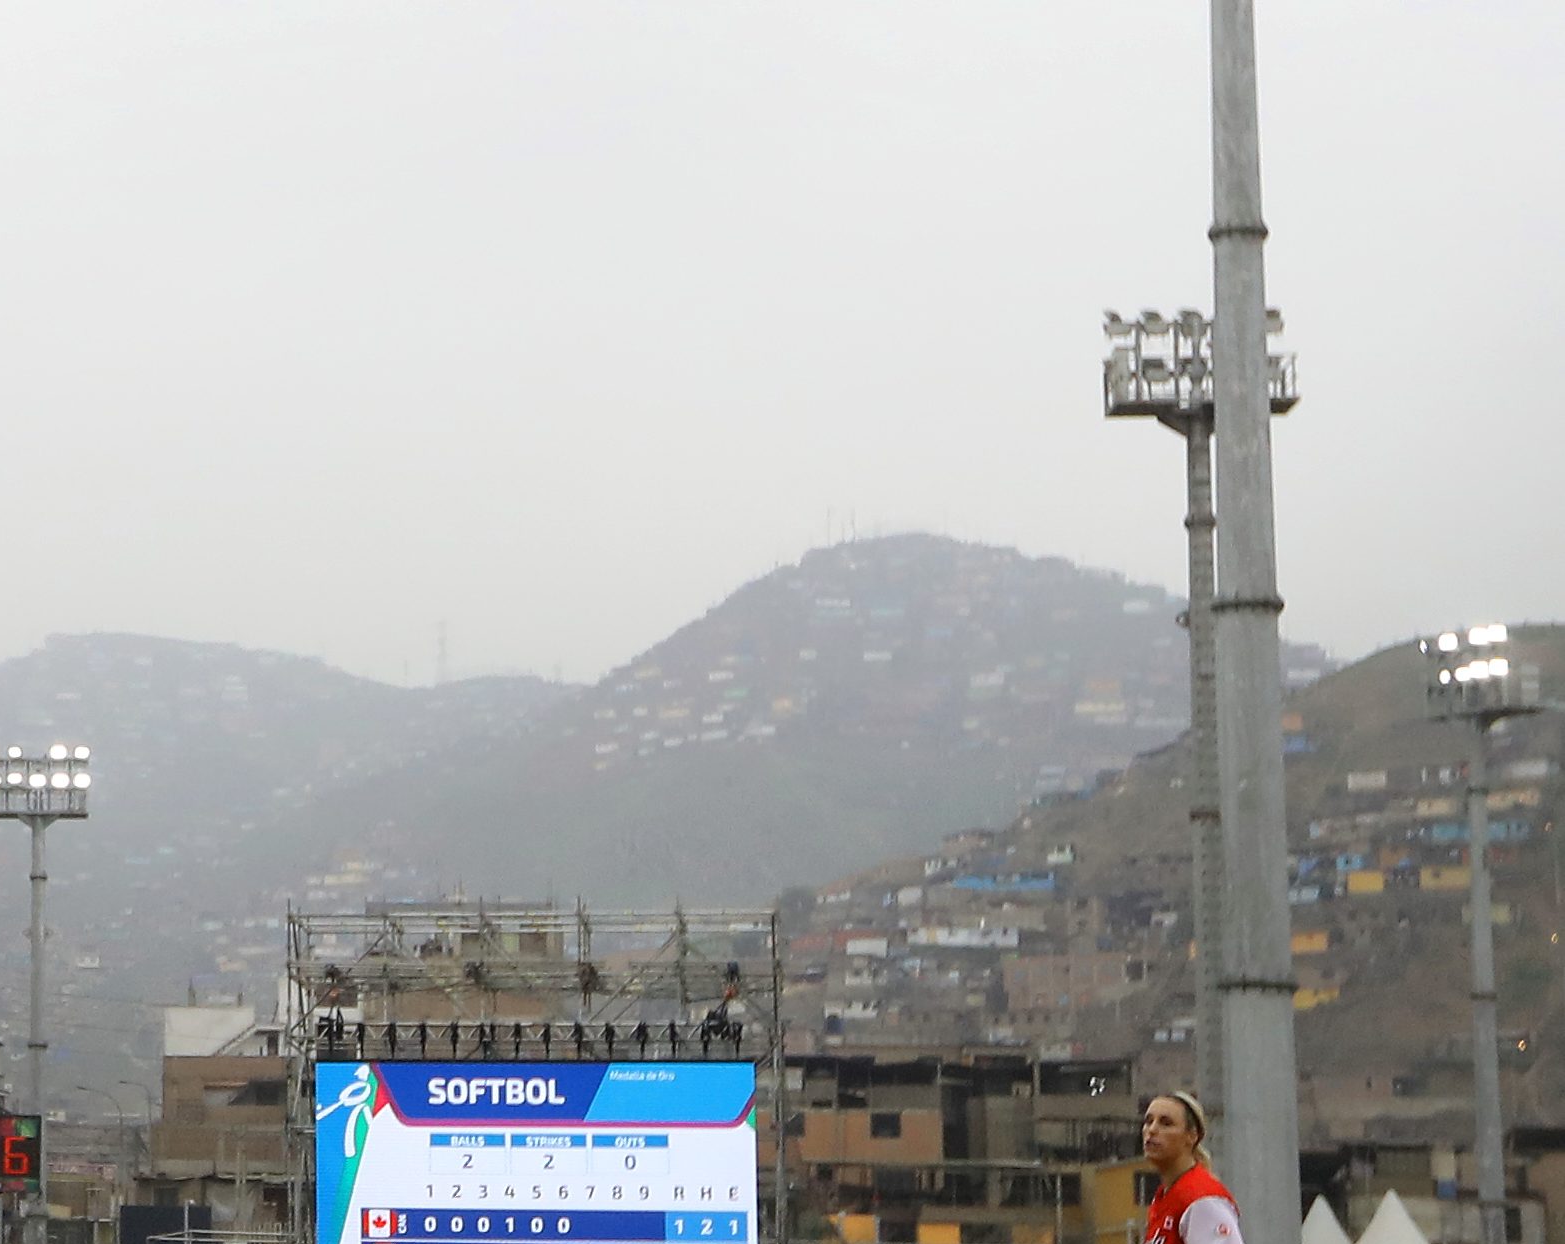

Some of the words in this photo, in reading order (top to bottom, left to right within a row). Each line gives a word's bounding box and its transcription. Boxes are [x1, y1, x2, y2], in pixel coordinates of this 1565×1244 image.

[428, 1077, 565, 1105] SOFTBOL
[450, 1136, 485, 1147] BALLS
[525, 1136, 571, 1147] STRIKES
[614, 1136, 645, 1148] OUTS
[462, 1154, 473, 1169] 2
[543, 1154, 554, 1169] 2
[624, 1154, 636, 1169] 0
[425, 1184, 434, 1198] 1
[452, 1184, 462, 1198] 2
[479, 1184, 488, 1198] 3
[504, 1184, 515, 1198] 4
[532, 1186, 542, 1199] 5
[558, 1186, 569, 1199] 6
[585, 1186, 596, 1199] 7
[612, 1186, 622, 1199] 8
[639, 1186, 649, 1199] 9
[674, 1187, 685, 1200] R
[700, 1187, 712, 1200] H
[729, 1187, 739, 1200] E
[424, 1216, 437, 1233] 0
[450, 1216, 464, 1233] 0
[477, 1216, 490, 1233] 0
[505, 1217, 515, 1233] 1
[530, 1217, 544, 1233] 0
[557, 1217, 571, 1234] 0
[674, 1219, 684, 1234] 1
[700, 1219, 713, 1235] 2
[729, 1219, 739, 1235] 1
